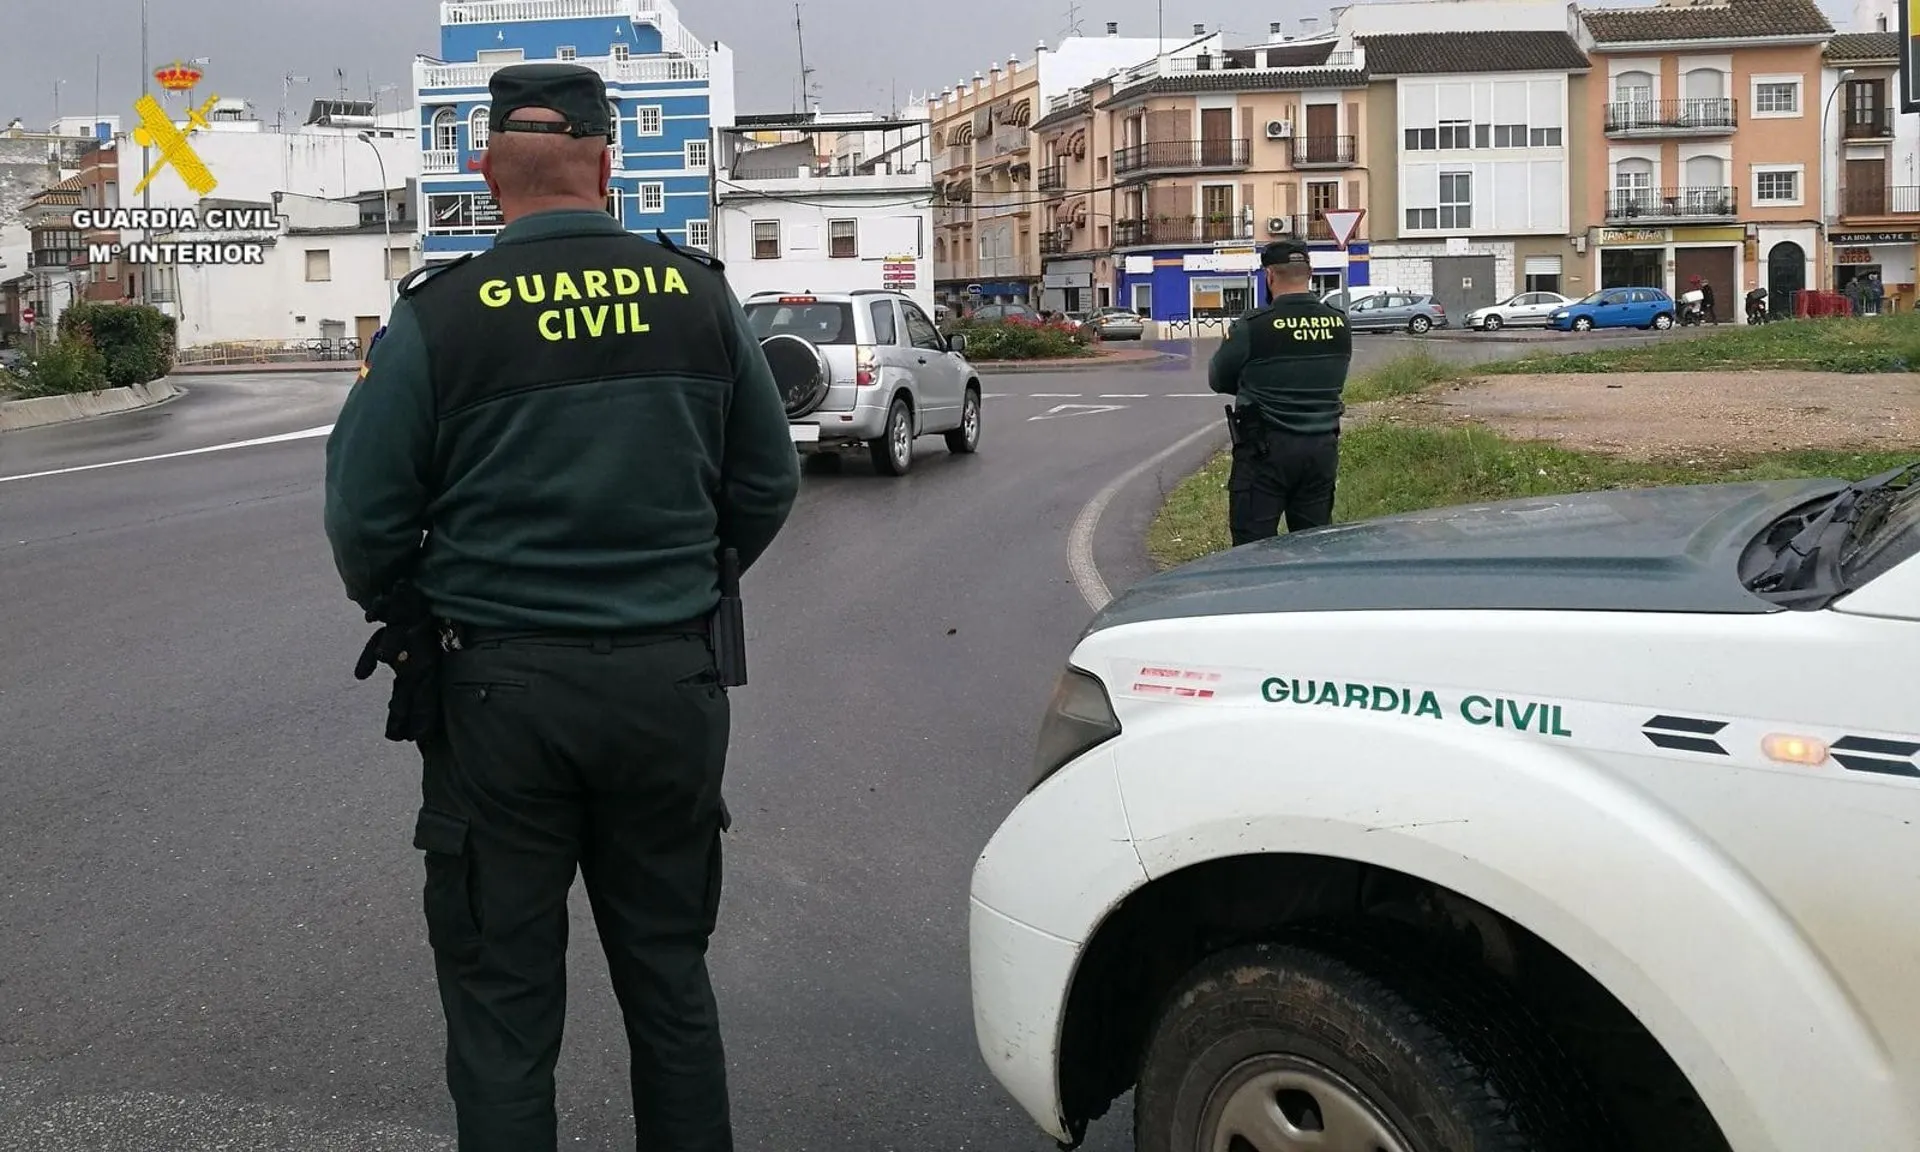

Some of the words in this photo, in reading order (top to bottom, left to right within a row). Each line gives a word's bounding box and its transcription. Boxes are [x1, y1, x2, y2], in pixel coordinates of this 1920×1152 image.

[479, 266, 690, 308] GUARDIA
[538, 302, 650, 341] CIVIL
[1273, 316, 1345, 329] GUARDIA
[1293, 328, 1334, 341] CIVIL
[1261, 676, 1443, 719] GUARDIA
[1460, 695, 1573, 738] CIVIL
